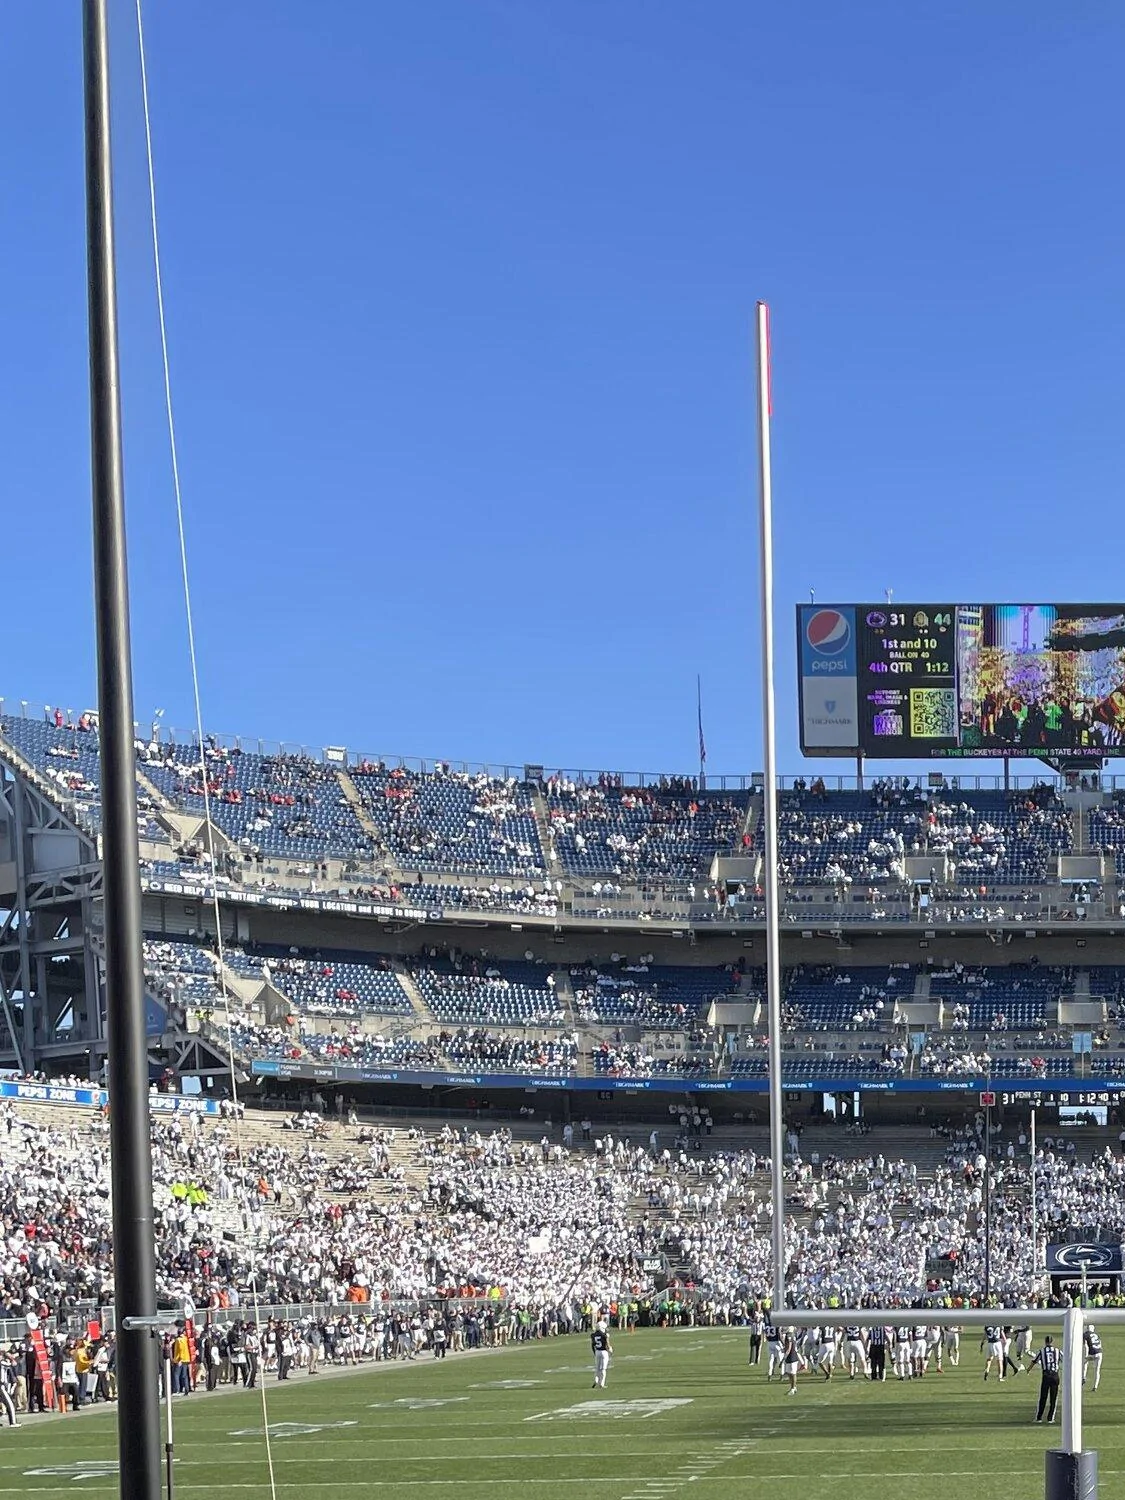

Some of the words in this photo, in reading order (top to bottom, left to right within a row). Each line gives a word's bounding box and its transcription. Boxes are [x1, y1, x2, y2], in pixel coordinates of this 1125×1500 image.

[889, 613, 906, 626] 31
[934, 612, 951, 626] 44
[881, 638, 898, 649] 1st
[900, 638, 921, 649] and
[923, 638, 938, 649] 10
[889, 651, 906, 659] BALL
[907, 651, 918, 659] ON
[811, 658, 848, 673] pepsi
[868, 661, 888, 673] 4th
[889, 661, 913, 673] QTR
[925, 661, 949, 673] 1:12
[963, 748, 1001, 756] BUCKEYES
[1002, 748, 1011, 756] AT
[1049, 748, 1072, 756] STATE
[322, 901, 357, 912] LOCATION
[17, 1084, 47, 1099] PEPSI
[50, 1088, 77, 1101] ZONE
[1002, 1092, 1015, 1105] 31
[1015, 1091, 1031, 1099] PENN
[1033, 1091, 1042, 1099] ST
[1060, 1093, 1069, 1102] 10
[178, 1100, 208, 1111] ZONE
[987, 1326, 1000, 1339] 34
[594, 1335, 603, 1349] 5
